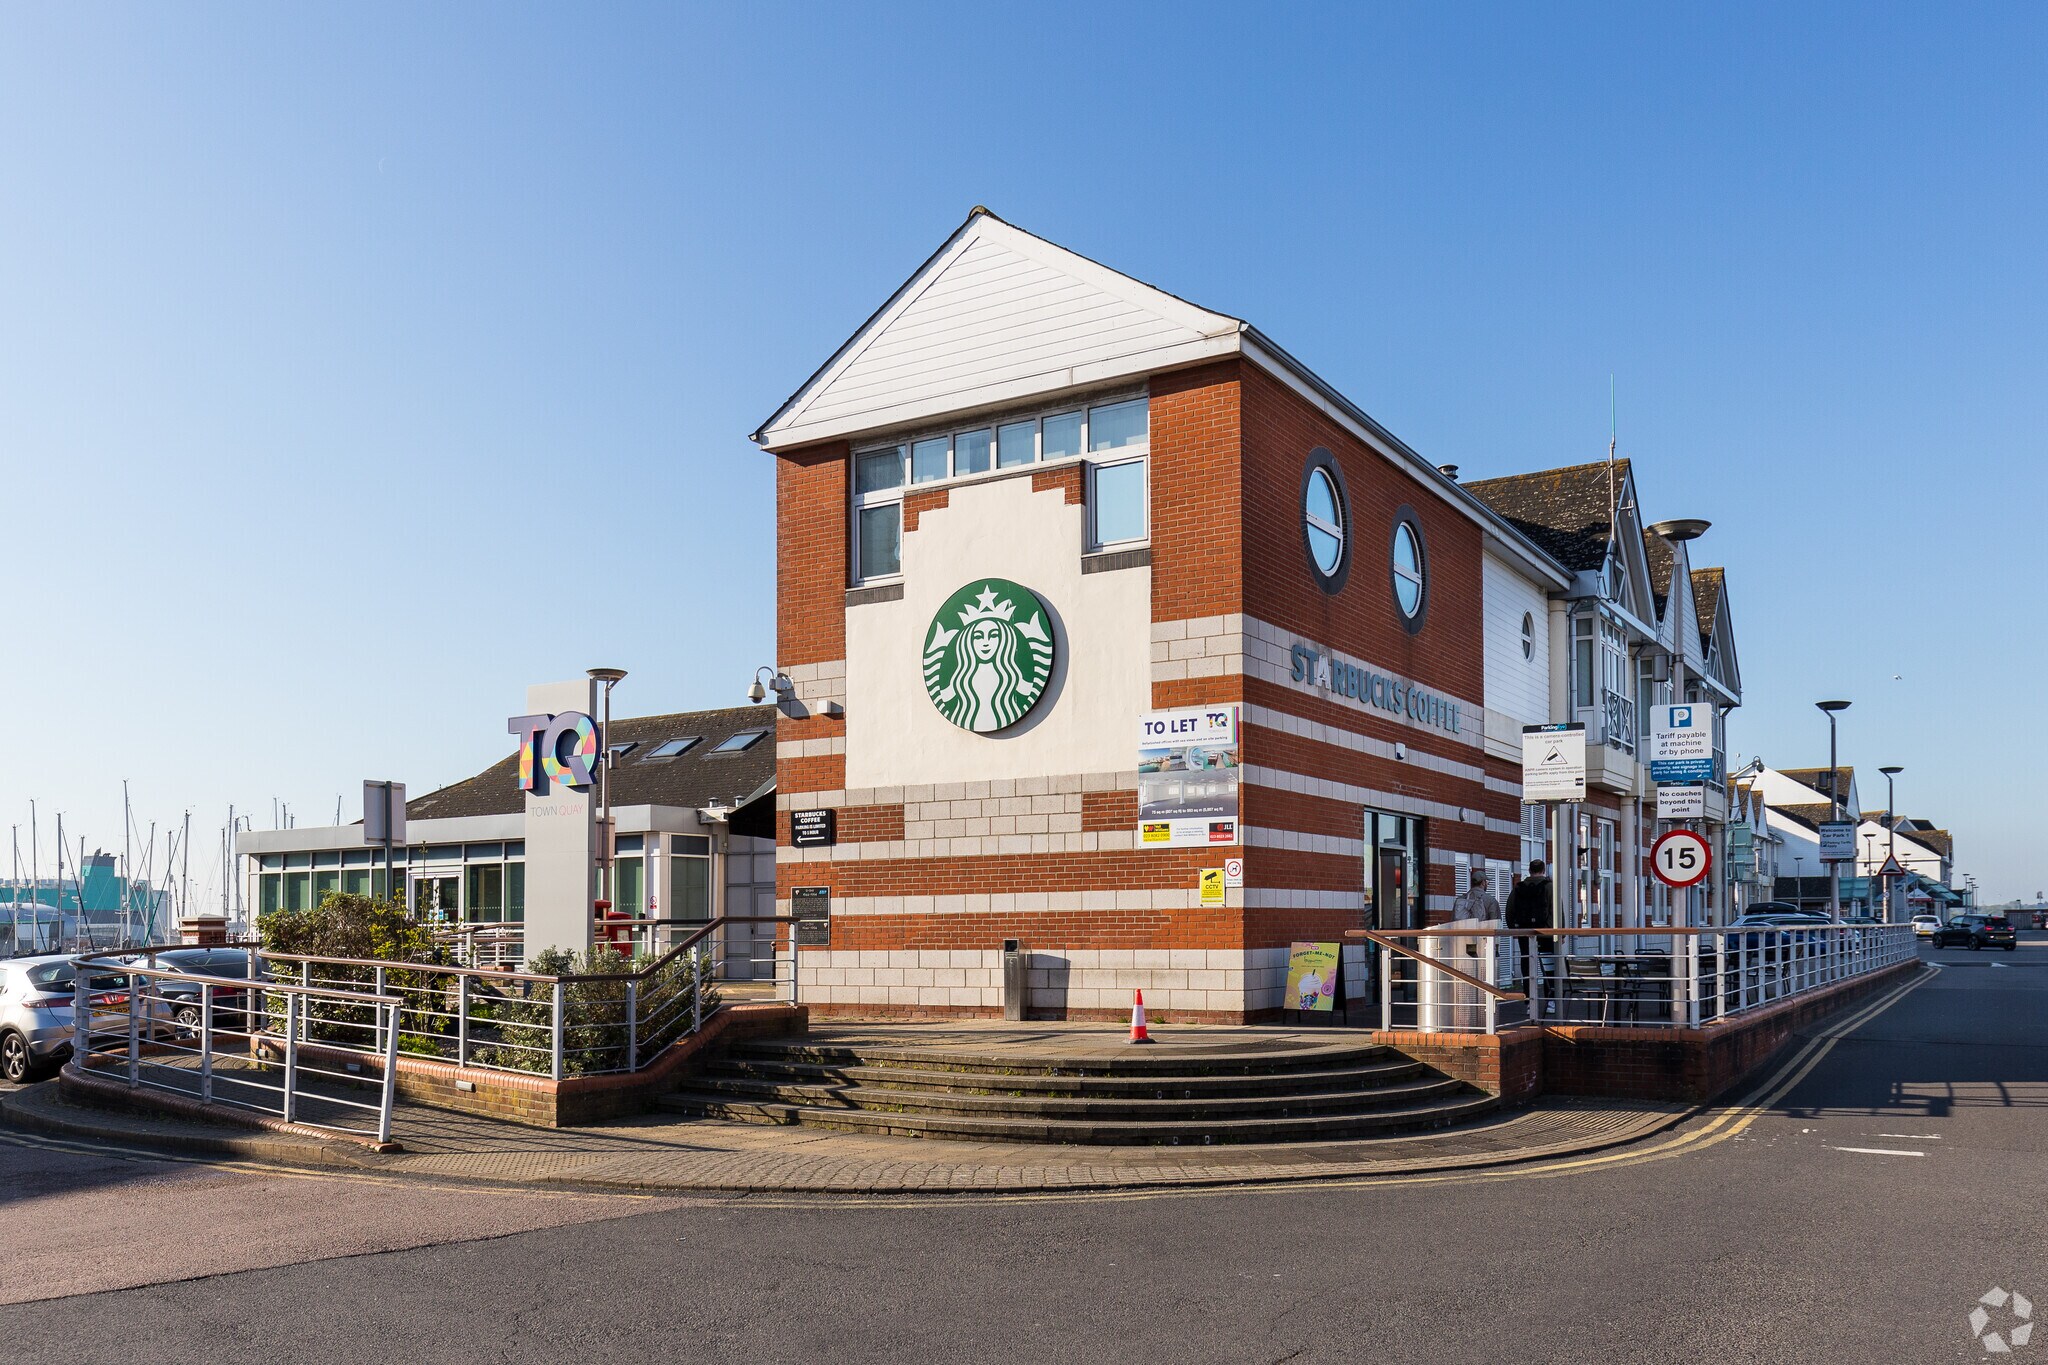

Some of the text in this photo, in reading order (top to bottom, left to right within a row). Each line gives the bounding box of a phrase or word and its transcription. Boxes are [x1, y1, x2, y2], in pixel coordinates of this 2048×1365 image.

[1291, 644, 1461, 734] STARBUCKS COFFEE
[1144, 718, 1197, 735] TO LET
[1206, 712, 1228, 728] TQ
[1677, 731, 1706, 740] payable
[508, 711, 600, 790] TQ
[530, 804, 584, 817] TOWN QUAY
[1664, 847, 1696, 870] 15
